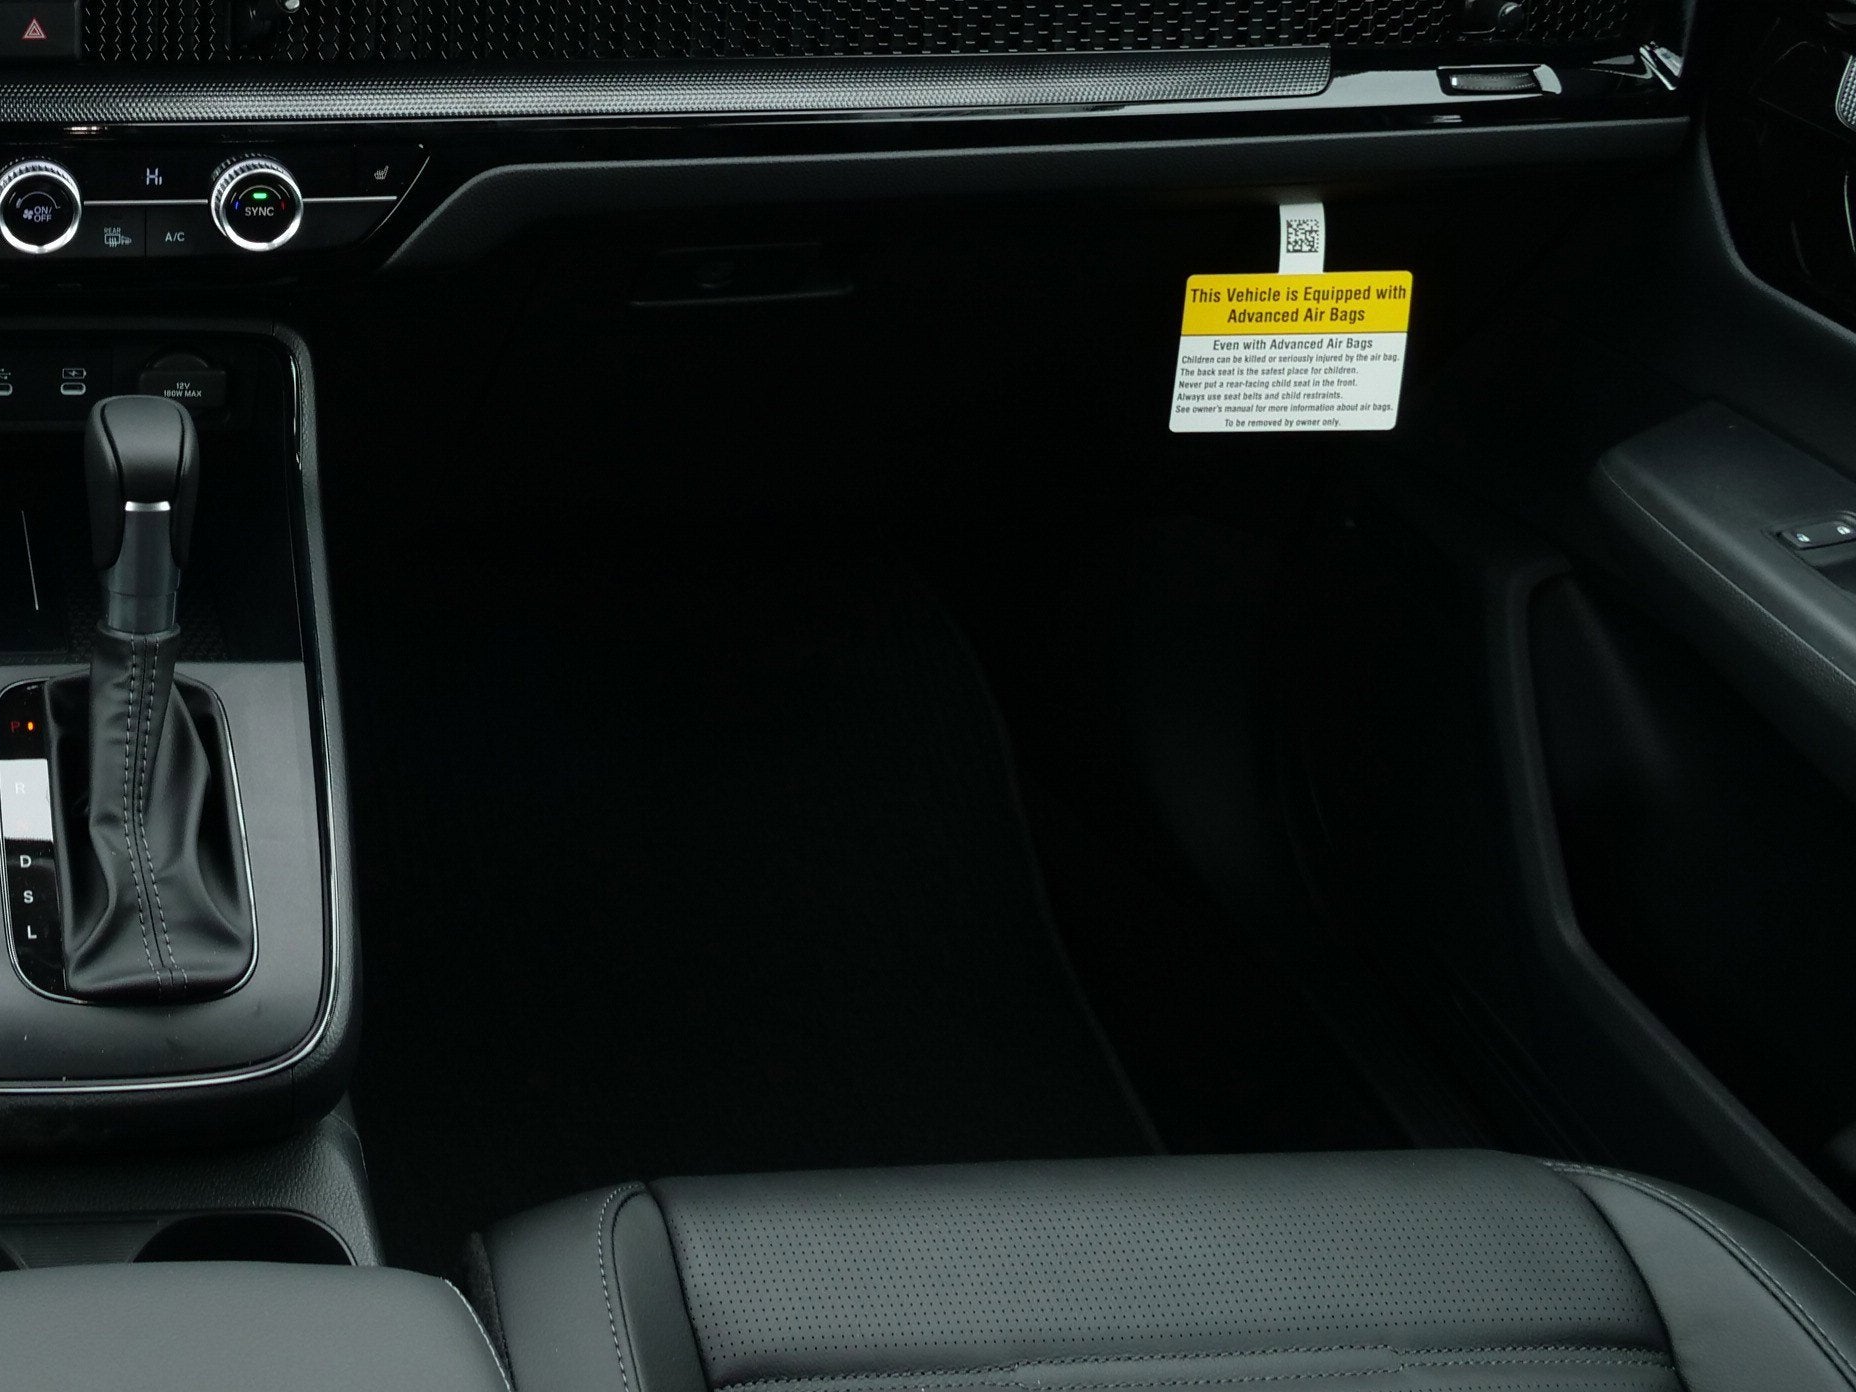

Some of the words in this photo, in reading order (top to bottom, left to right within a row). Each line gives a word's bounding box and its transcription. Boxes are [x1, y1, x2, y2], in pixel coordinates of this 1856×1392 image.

[244, 206, 275, 217] SYNC
[33, 214, 52, 223] OFF
[104, 227, 121, 235] REAR
[165, 232, 185, 243] A/C
[1190, 288, 1221, 303] This
[1227, 287, 1280, 302] Vehicle
[1285, 287, 1299, 301] is
[1304, 285, 1371, 304] Equipped
[1376, 284, 1407, 300] with
[1227, 308, 1299, 323] Advanced
[1303, 307, 1325, 322] Air
[1330, 307, 1366, 324] Bags
[1213, 339, 1239, 350] Even
[1244, 339, 1266, 350] with
[1269, 338, 1323, 350] Advanced
[1326, 338, 1343, 349] Air
[1346, 337, 1373, 350] Bags
[1181, 355, 1214, 364] Children
[1217, 356, 1231, 364] can
[1233, 356, 1242, 364] be
[1245, 355, 1266, 363] killed
[1279, 355, 1313, 366] seriously
[1316, 354, 1343, 364] injured
[1345, 354, 1354, 364] by
[1356, 354, 1368, 362] the
[1370, 353, 1381, 361] air
[1383, 353, 1399, 362] bag.
[1180, 368, 1195, 376] The
[1197, 367, 1215, 376] back
[1218, 368, 1235, 376] seat
[1261, 367, 1285, 375] safest
[1286, 367, 1308, 377] place
[1311, 367, 1322, 375] for
[1324, 366, 1359, 375] children.
[176, 381, 191, 390] 12V
[1178, 380, 1202, 389] Never
[1204, 381, 1217, 390] put
[1226, 379, 1269, 389] rear-facing
[1271, 379, 1291, 388] child
[1293, 379, 1310, 387] seat
[1337, 378, 1358, 386] front.
[184, 389, 202, 398] MAX
[1176, 393, 1205, 402] Always
[1243, 392, 1263, 401] belts
[1265, 392, 1280, 400] and
[1282, 392, 1301, 400] child
[1302, 391, 1343, 399] restraints.
[1175, 405, 1190, 413] See
[1192, 405, 1223, 413] owner's
[1224, 404, 1253, 413] manual
[1255, 404, 1266, 413] for
[1290, 404, 1334, 412] information
[1336, 404, 1358, 412] about
[1360, 403, 1371, 411] air
[1373, 403, 1393, 412] bags.
[1225, 419, 1234, 427] To
[1235, 419, 1245, 427] be
[1248, 418, 1282, 427] removed
[1284, 419, 1294, 428] by
[1322, 418, 1341, 427] only.
[14, 782, 26, 796] R
[19, 854, 32, 869] D
[22, 889, 35, 904] S
[27, 925, 38, 939] L
